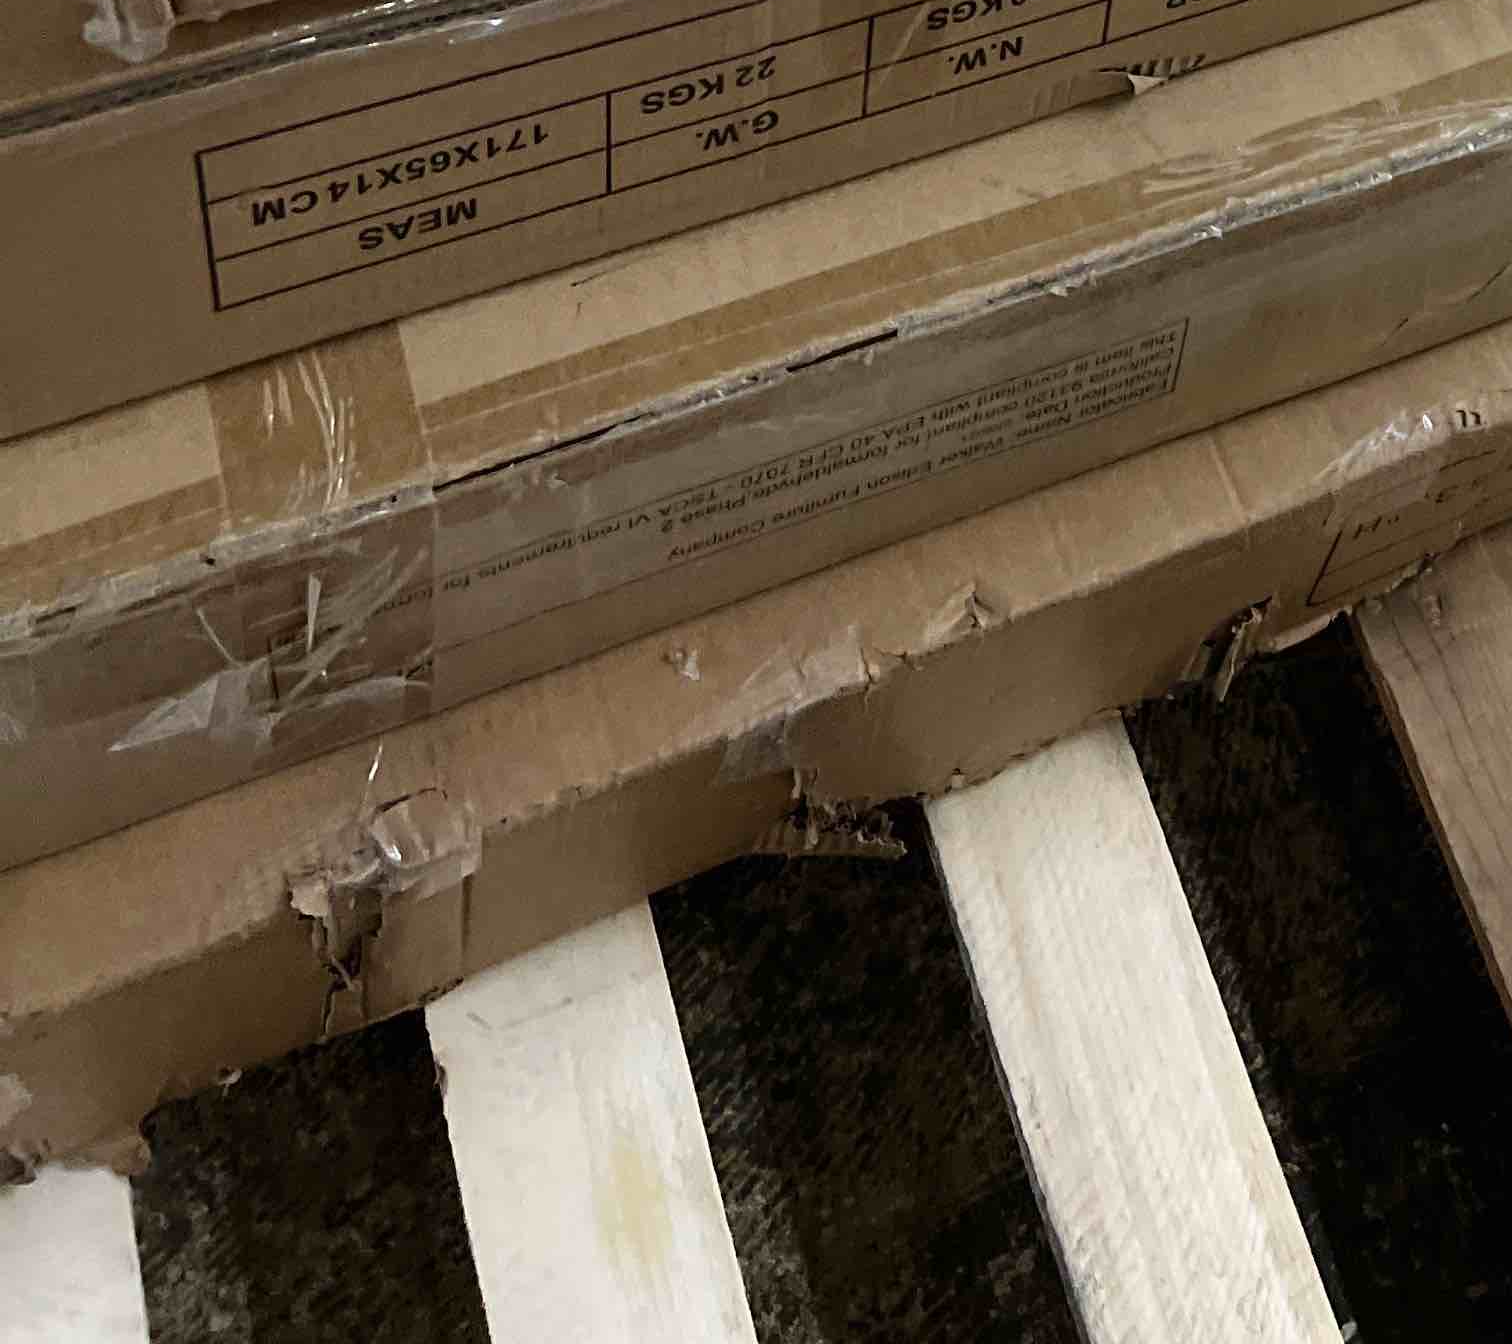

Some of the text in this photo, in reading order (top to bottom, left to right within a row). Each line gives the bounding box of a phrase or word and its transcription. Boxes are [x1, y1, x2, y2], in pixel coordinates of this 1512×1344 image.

[947, 32, 1026, 74] N.W.
[640, 55, 777, 116] 22 KGS
[697, 109, 780, 152] G.W.
[252, 122, 548, 227] 171X65X14 CM
[358, 196, 480, 252] MEAS
